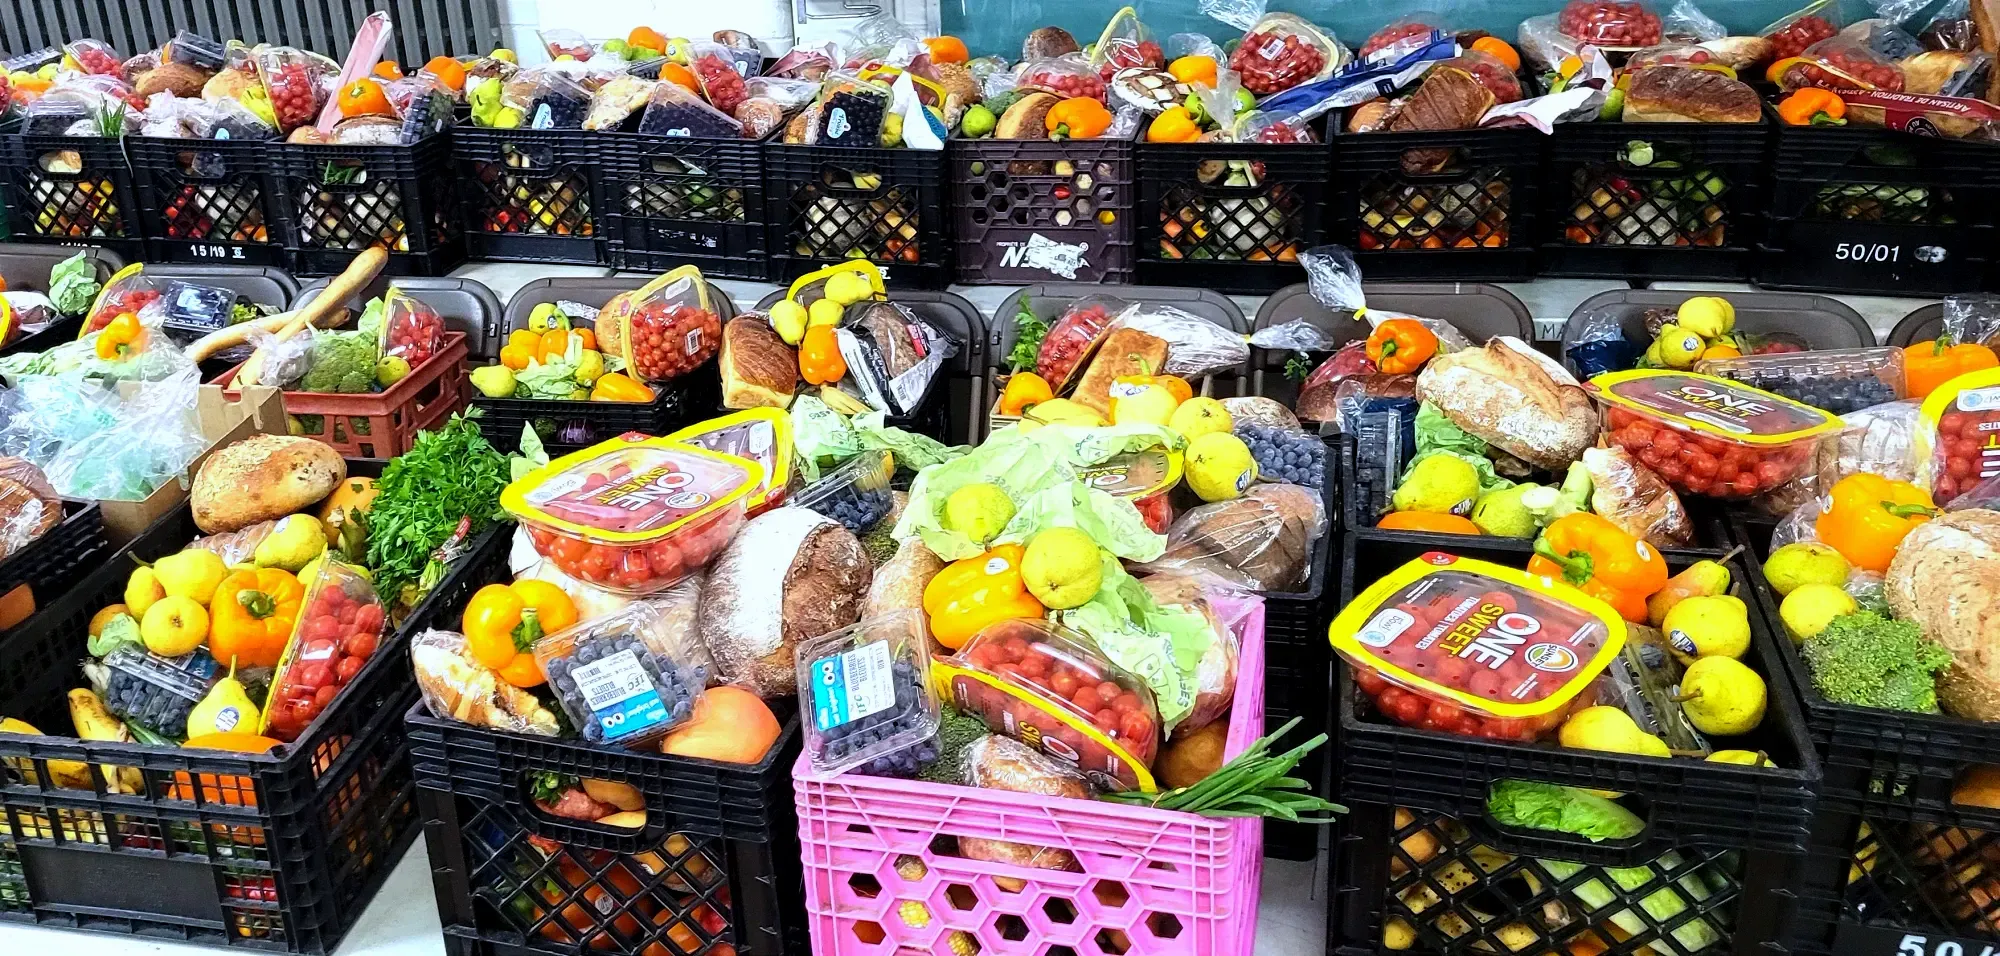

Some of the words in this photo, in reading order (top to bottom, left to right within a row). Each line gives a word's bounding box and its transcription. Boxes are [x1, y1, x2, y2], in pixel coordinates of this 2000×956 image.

[1835, 243, 1900, 263] 50/01
[1667, 390, 1751, 417] SWEET
[1680, 386, 1776, 416] ONE
[596, 466, 670, 505] SWEET
[1077, 468, 1128, 480] SWE
[611, 472, 695, 511] ONE
[1439, 602, 1505, 657] SWEET
[1459, 612, 1541, 670] ONE
[1533, 643, 1558, 667] SUNSET
[627, 674, 645, 690] IFC
[854, 695, 867, 714] IFC
[1896, 934, 2000, 956] 50/
